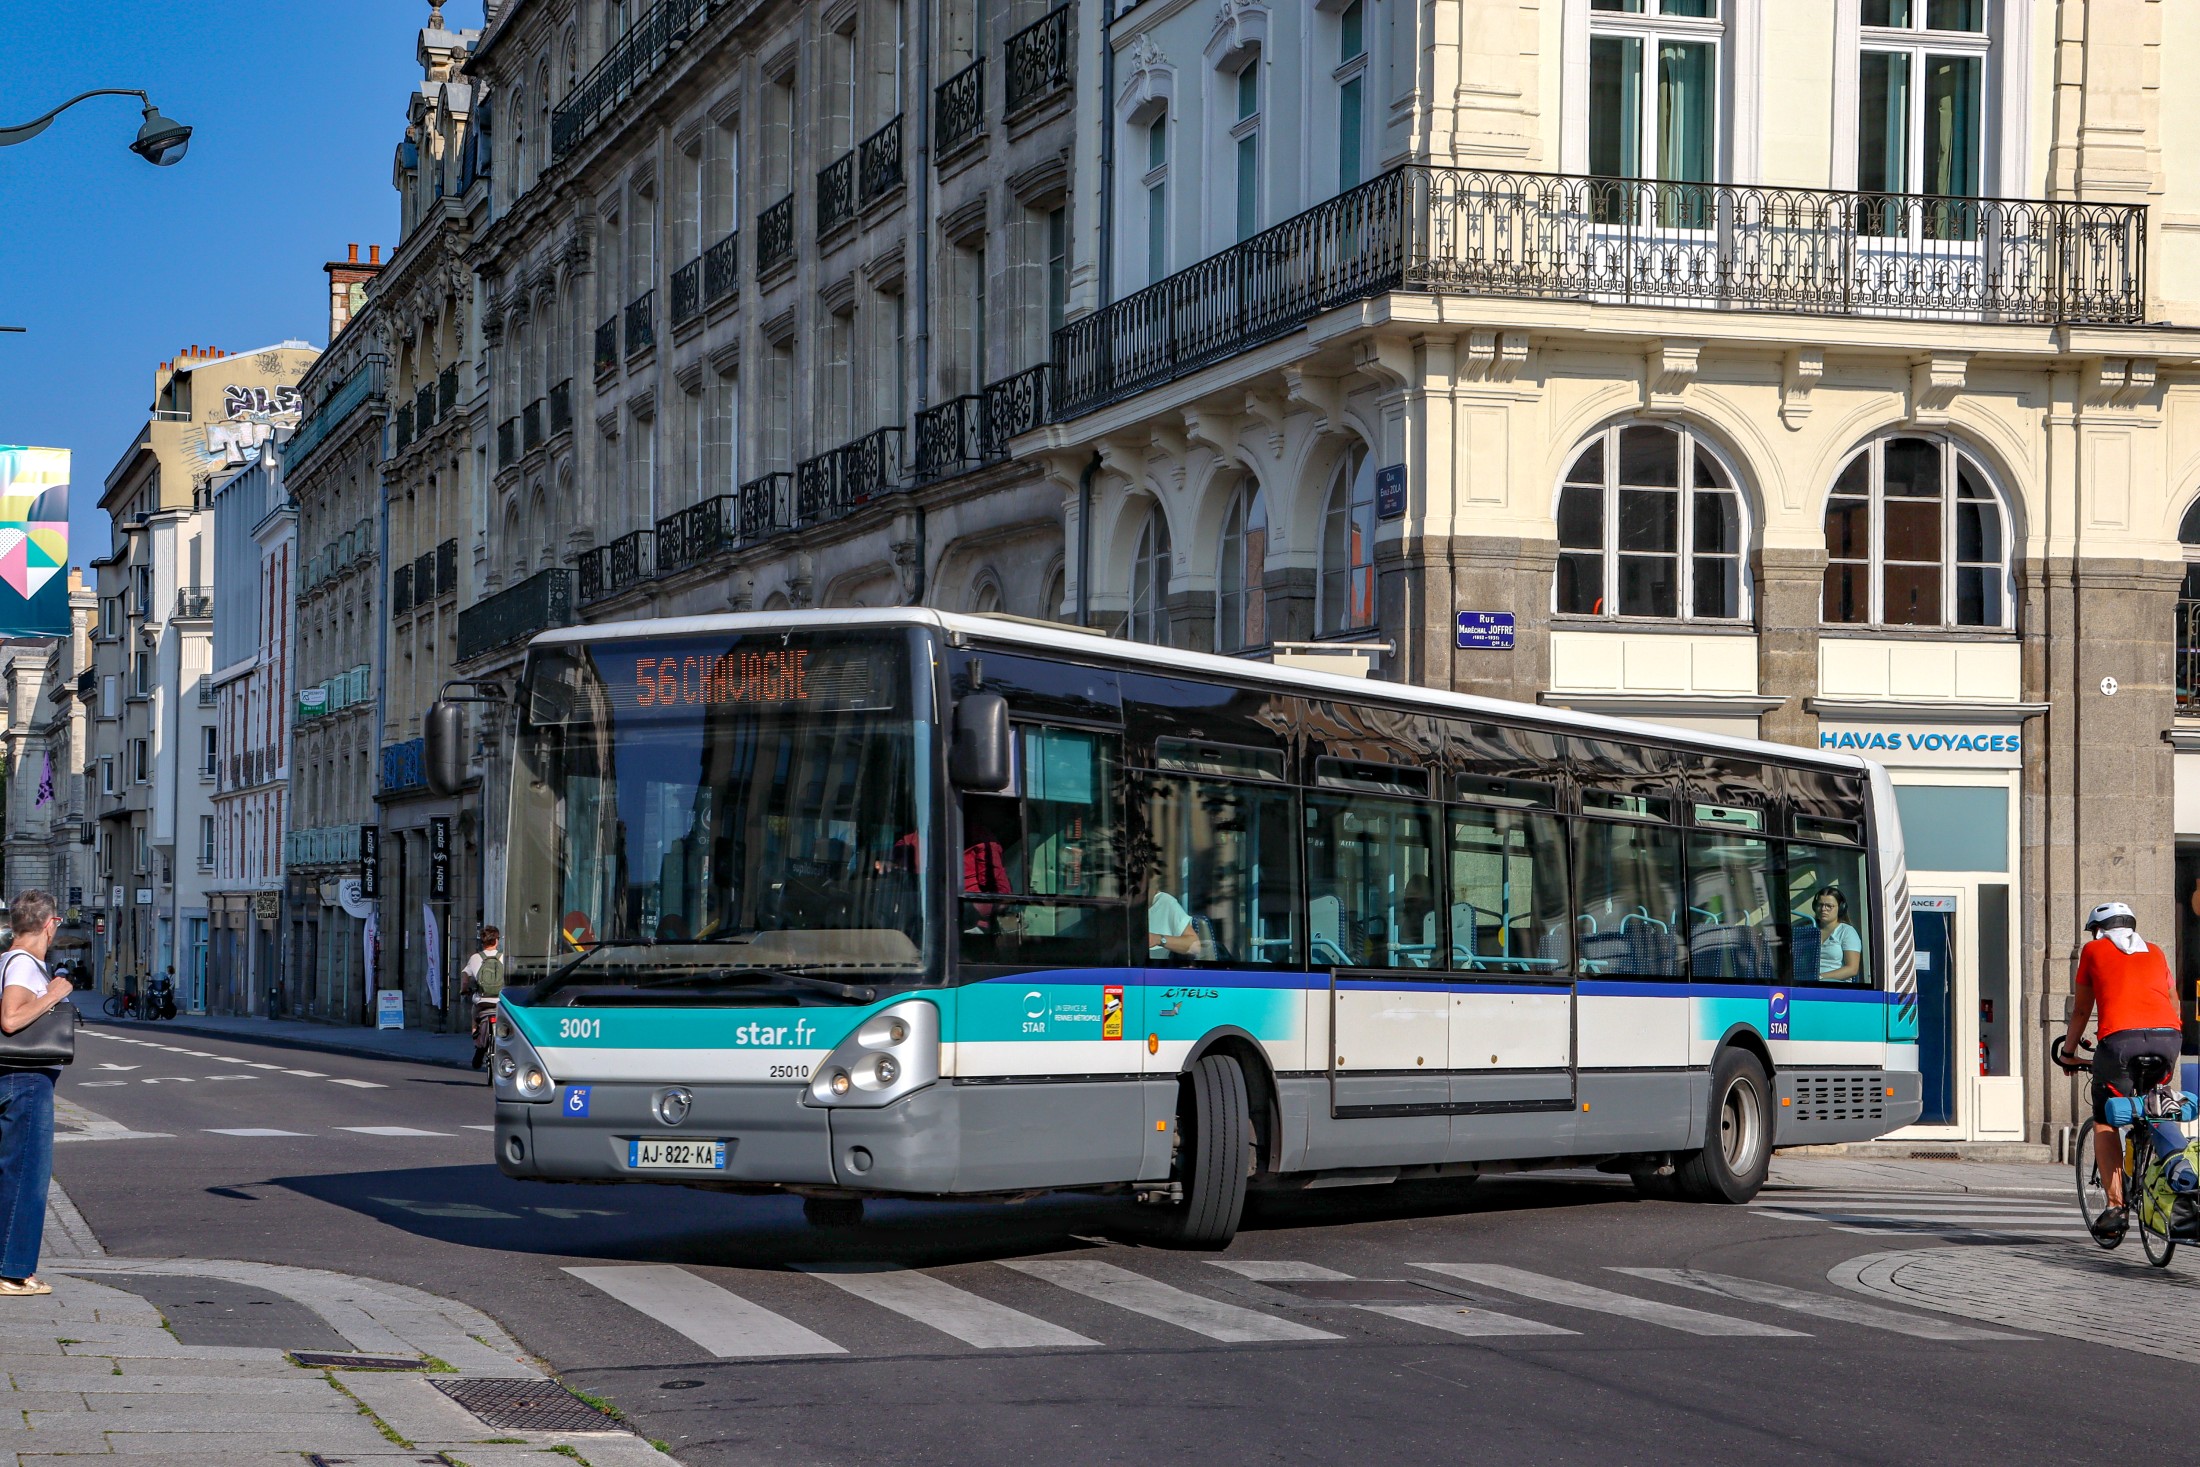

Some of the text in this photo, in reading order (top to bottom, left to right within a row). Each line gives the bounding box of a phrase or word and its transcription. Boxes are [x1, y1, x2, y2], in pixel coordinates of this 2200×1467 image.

[1390, 483, 1402, 494] ZOLA
[1479, 614, 1494, 624] RUE
[1488, 625, 1514, 634] JOFFRE
[636, 650, 808, 706] 56 CHAVAGNE
[1820, 731, 2020, 752] HAVAS VOYAGES
[366, 831, 375, 854] sport
[436, 823, 445, 848] sport
[560, 1018, 601, 1039] 3001
[735, 1018, 816, 1046] star.fr
[1022, 1022, 1045, 1033] STAR
[1770, 1022, 1788, 1034] STAR
[769, 1065, 809, 1078] 25010
[642, 1145, 712, 1164] AJ-822-KA
